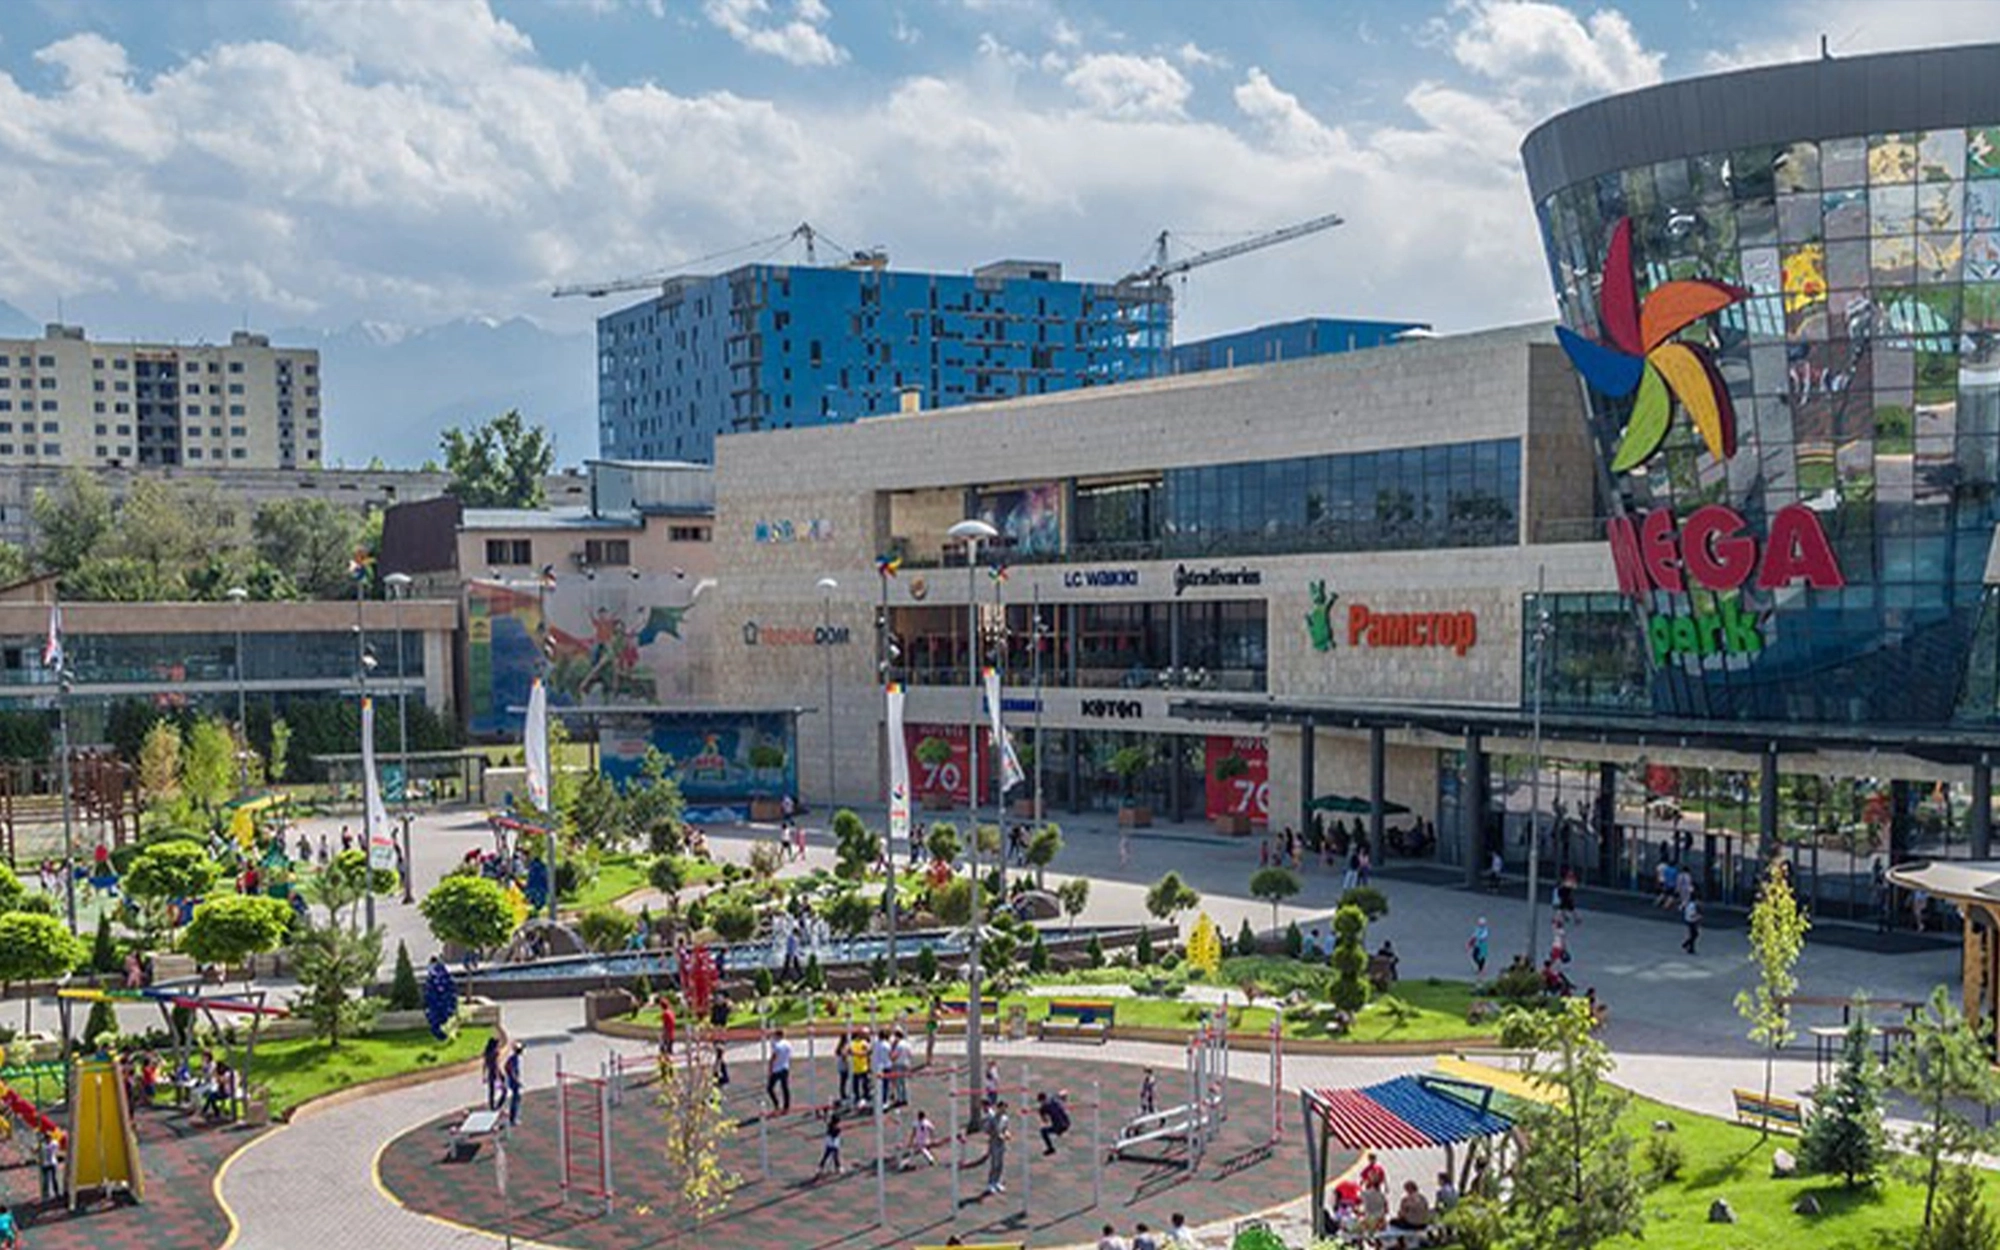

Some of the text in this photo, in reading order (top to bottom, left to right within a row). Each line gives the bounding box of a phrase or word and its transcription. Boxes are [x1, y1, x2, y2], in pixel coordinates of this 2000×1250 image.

[1606, 504, 1845, 597] MEGA
[1064, 571, 1082, 588] LC
[1348, 604, 1477, 656] Рамстор
[1652, 596, 1762, 666] park
[922, 762, 961, 791] 70
